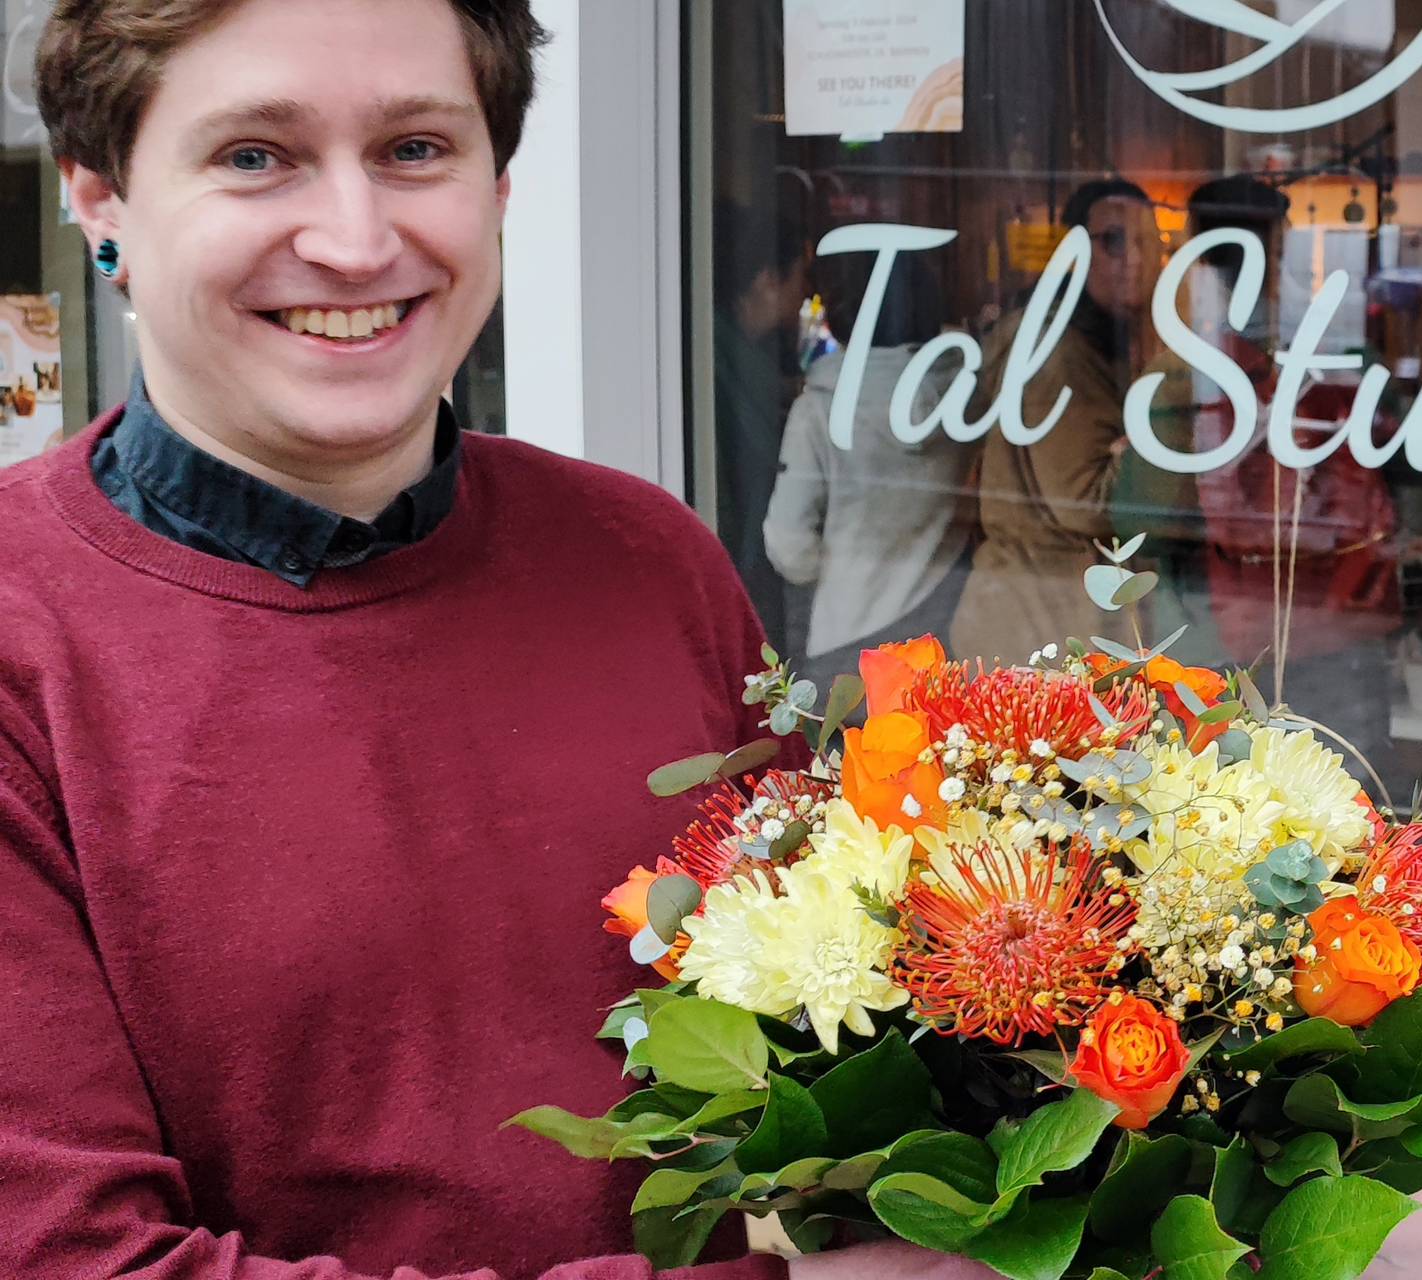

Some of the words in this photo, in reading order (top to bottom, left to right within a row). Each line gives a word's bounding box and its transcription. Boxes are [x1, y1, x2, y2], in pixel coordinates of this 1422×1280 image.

[816, 77, 836, 92] SEE
[840, 75, 866, 90] YOU
[869, 74, 917, 89] THERE!
[815, 223, 1091, 450] Tal
